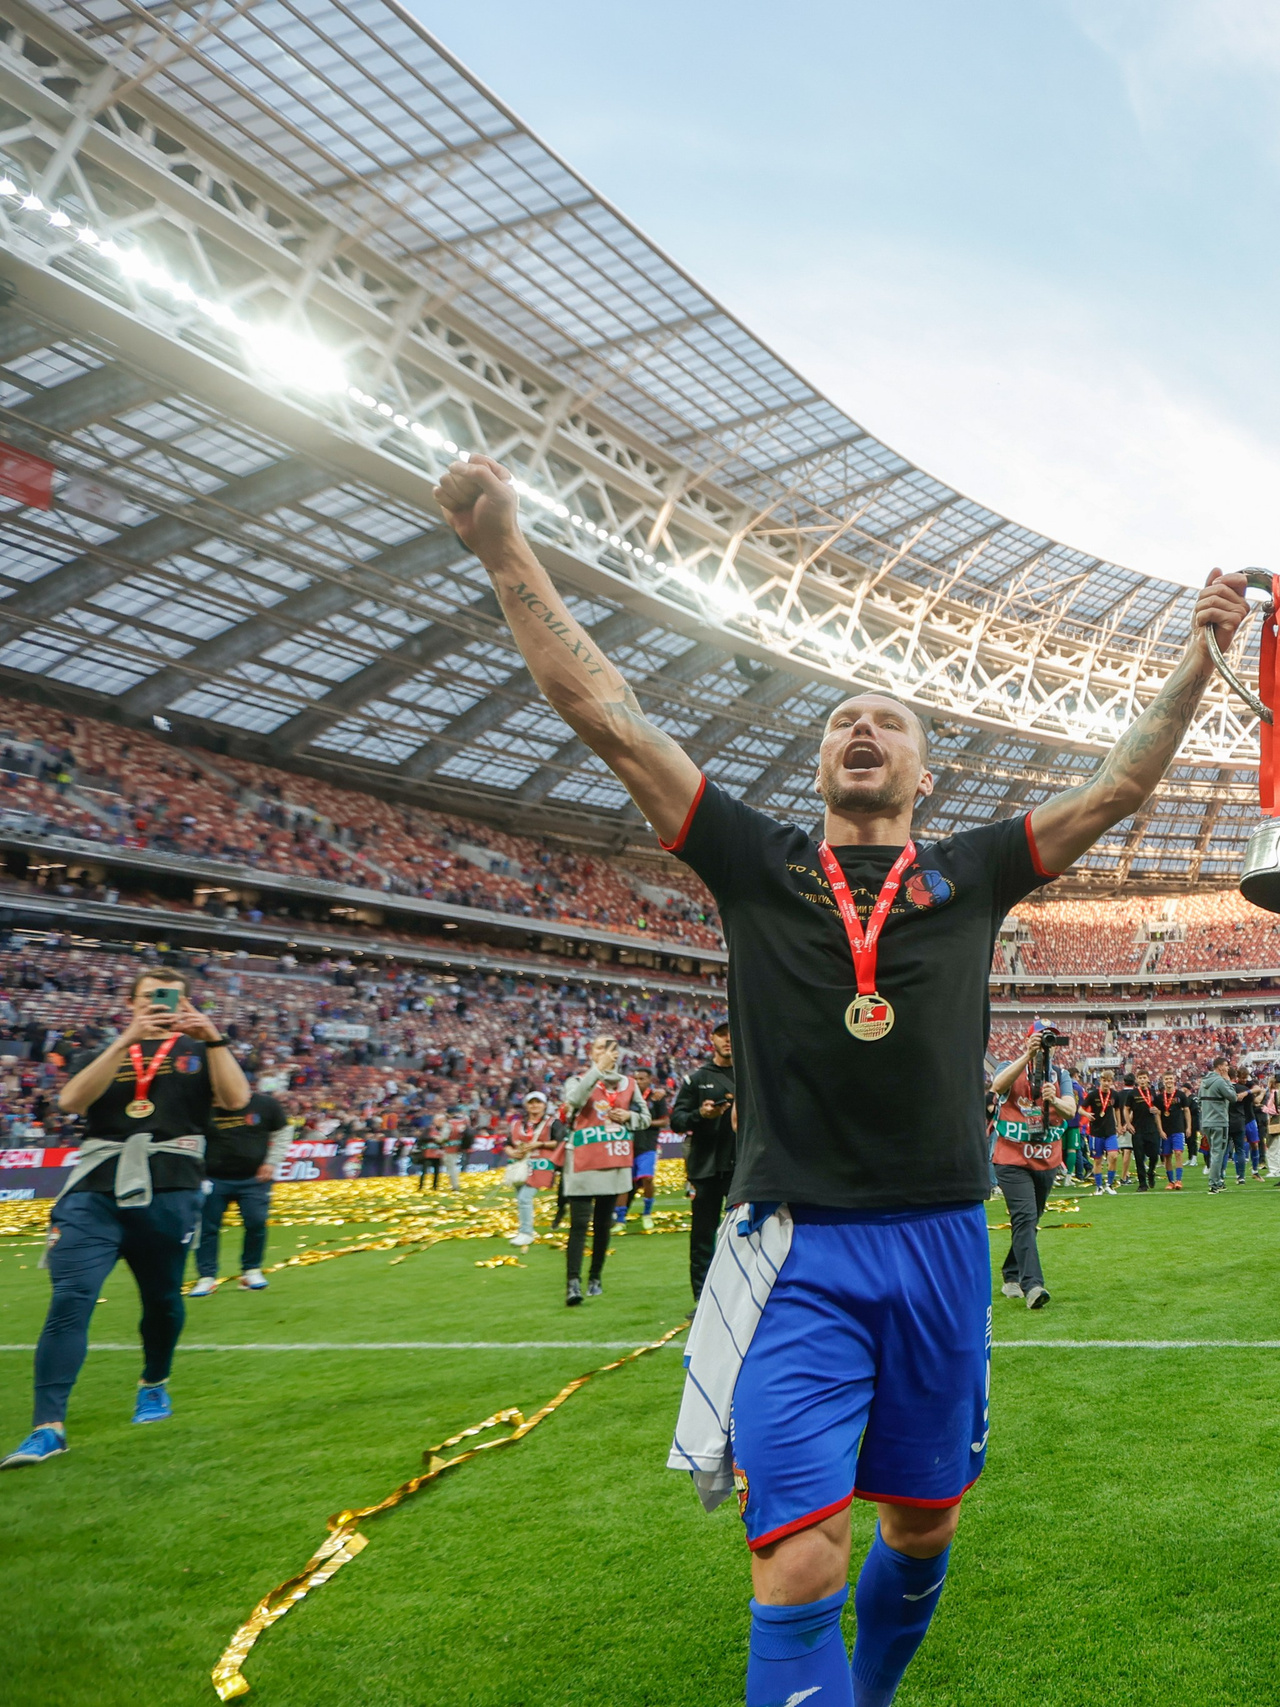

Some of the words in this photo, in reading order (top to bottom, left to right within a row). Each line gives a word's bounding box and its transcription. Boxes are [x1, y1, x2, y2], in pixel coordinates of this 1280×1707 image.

[509, 582, 603, 676] MCMLXVI
[605, 1141, 631, 1156] 183
[1023, 1143, 1053, 1159] 026
